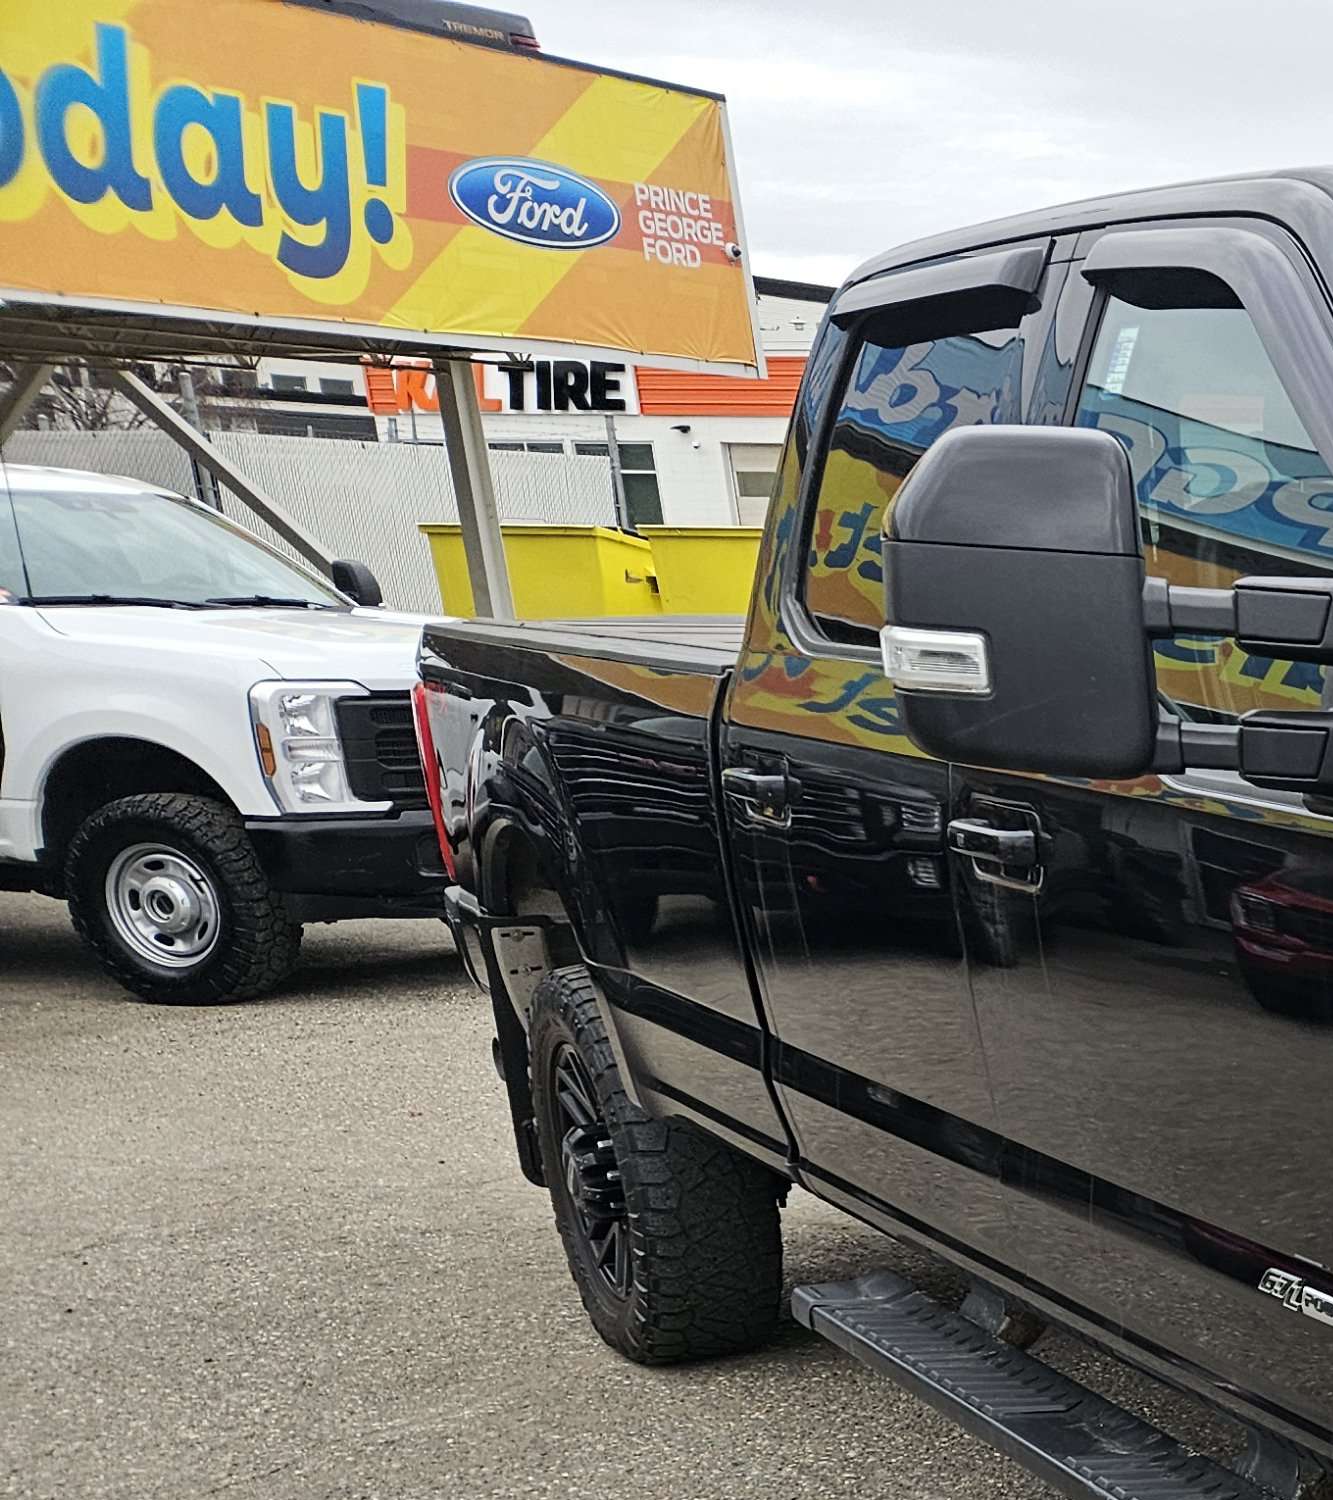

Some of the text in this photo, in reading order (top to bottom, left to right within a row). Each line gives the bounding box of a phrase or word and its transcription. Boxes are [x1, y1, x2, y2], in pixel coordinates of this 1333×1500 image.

[487, 167, 590, 238] Ford
[633, 182, 713, 218] PRINCE
[638, 210, 724, 246] GEORGE
[642, 237, 701, 268] FORD
[395, 359, 626, 412] KL TIRE
